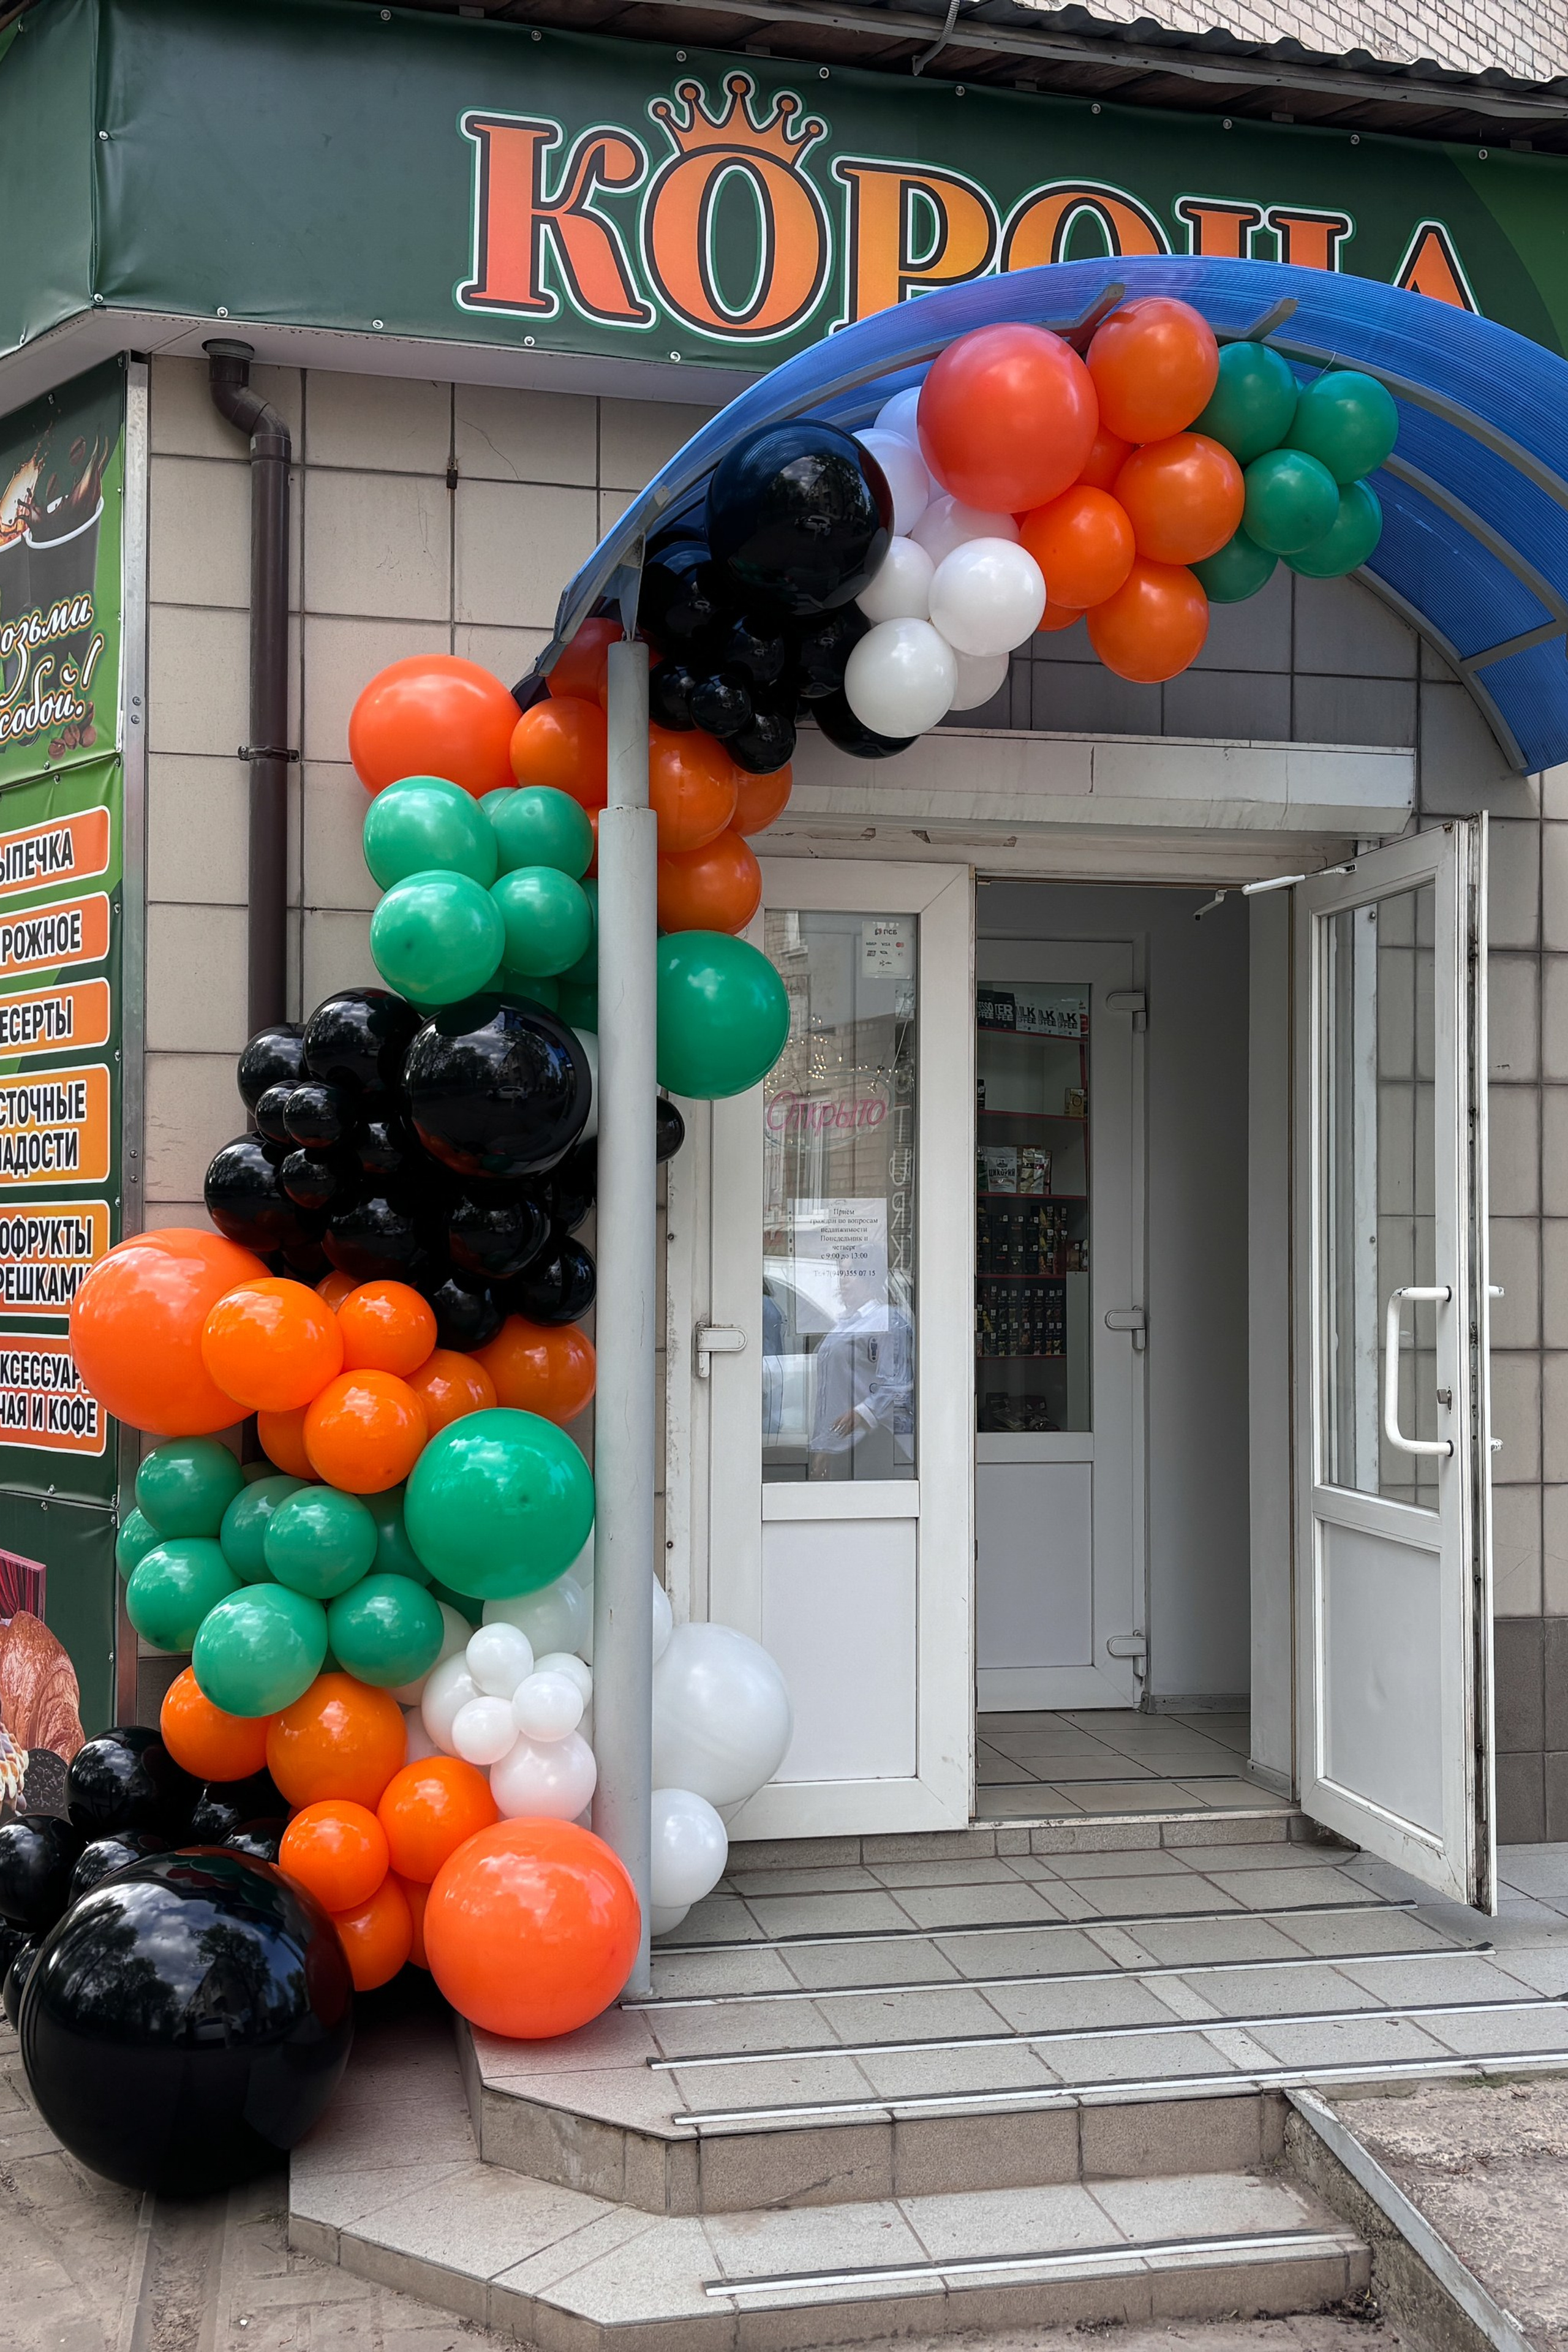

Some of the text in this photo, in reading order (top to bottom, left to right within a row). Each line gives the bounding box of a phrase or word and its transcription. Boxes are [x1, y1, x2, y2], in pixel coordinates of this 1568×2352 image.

[0, 1131, 78, 1175] АДОСТИ
[0, 1353, 88, 1390] КСЕССУАР
[32, 1396, 43, 1428] И
[48, 1398, 96, 1434] КОФЕ
